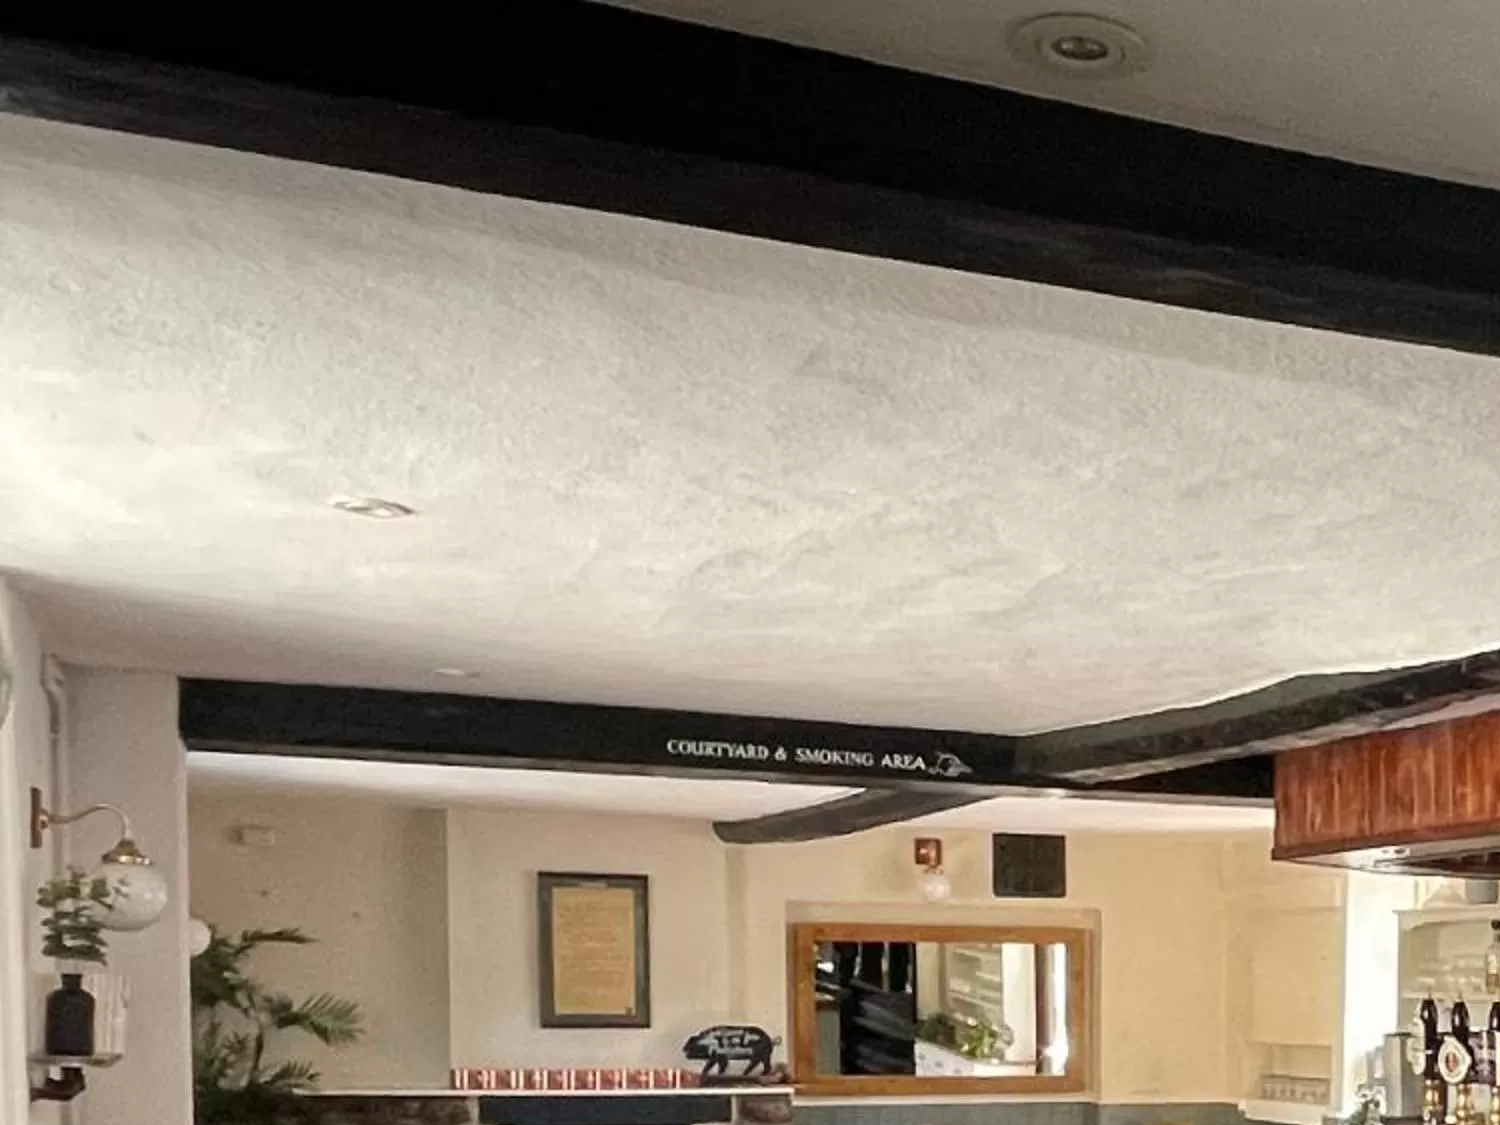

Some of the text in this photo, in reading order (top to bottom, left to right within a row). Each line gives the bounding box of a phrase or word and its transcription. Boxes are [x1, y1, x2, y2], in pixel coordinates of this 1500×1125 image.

[666, 739, 926, 771] COURTYARD & SMOKING AREA
